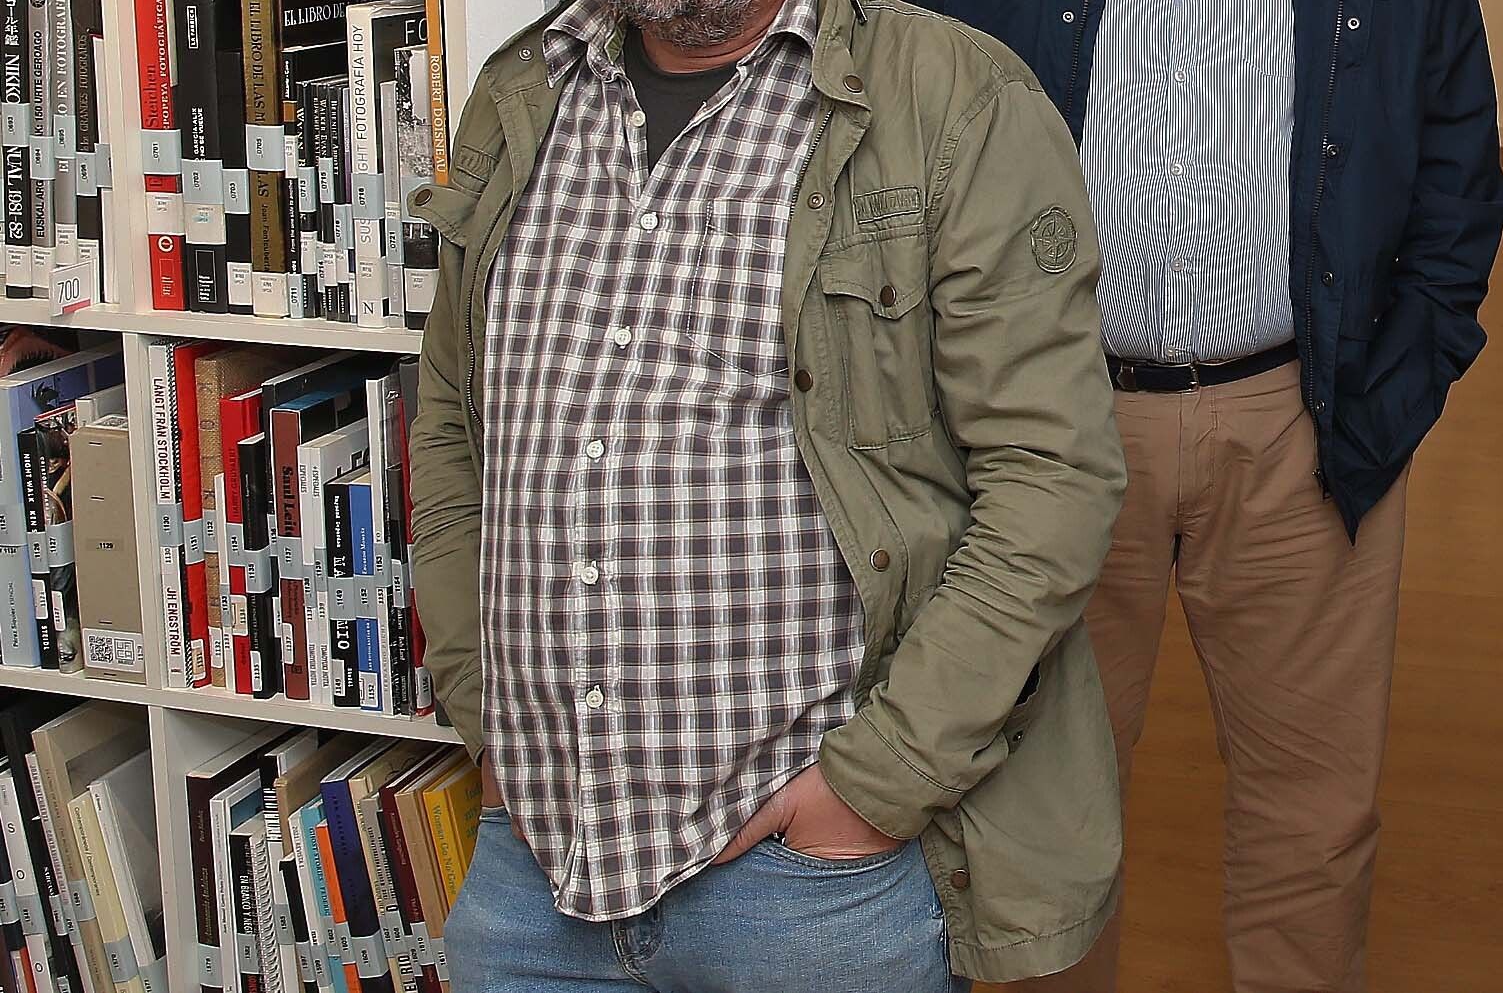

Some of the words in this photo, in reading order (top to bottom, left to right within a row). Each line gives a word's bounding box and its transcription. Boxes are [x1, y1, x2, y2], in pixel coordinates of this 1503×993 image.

[250, 2, 261, 16] EL
[284, 9, 297, 27] EL
[298, 5, 331, 25] LIBRO
[333, 2, 346, 19] DE
[250, 20, 264, 62] LIBRO
[352, 25, 364, 52] HOY
[33, 30, 43, 78] GEROAGO
[252, 64, 264, 80] DE
[430, 55, 444, 103] ROBERT
[34, 79, 43, 104] URTE
[143, 64, 158, 128] Steichen
[253, 83, 266, 109] LAS
[352, 56, 367, 140] FOTOGRAFÍA
[34, 105, 44, 122] 150
[319, 99, 328, 133] WALKER
[433, 108, 447, 173] DOISNEAU
[9, 189, 24, 240] 1981-82
[35, 202, 46, 238] EUSKAL
[57, 277, 80, 304] 700
[23, 453, 33, 478] NIGHT
[157, 440, 172, 499] STOCKHOLM
[26, 480, 35, 503] WALK
[282, 466, 294, 500] Saul
[166, 587, 178, 601] JH
[41, 625, 51, 651] STEIDL
[239, 875, 249, 887] EN
